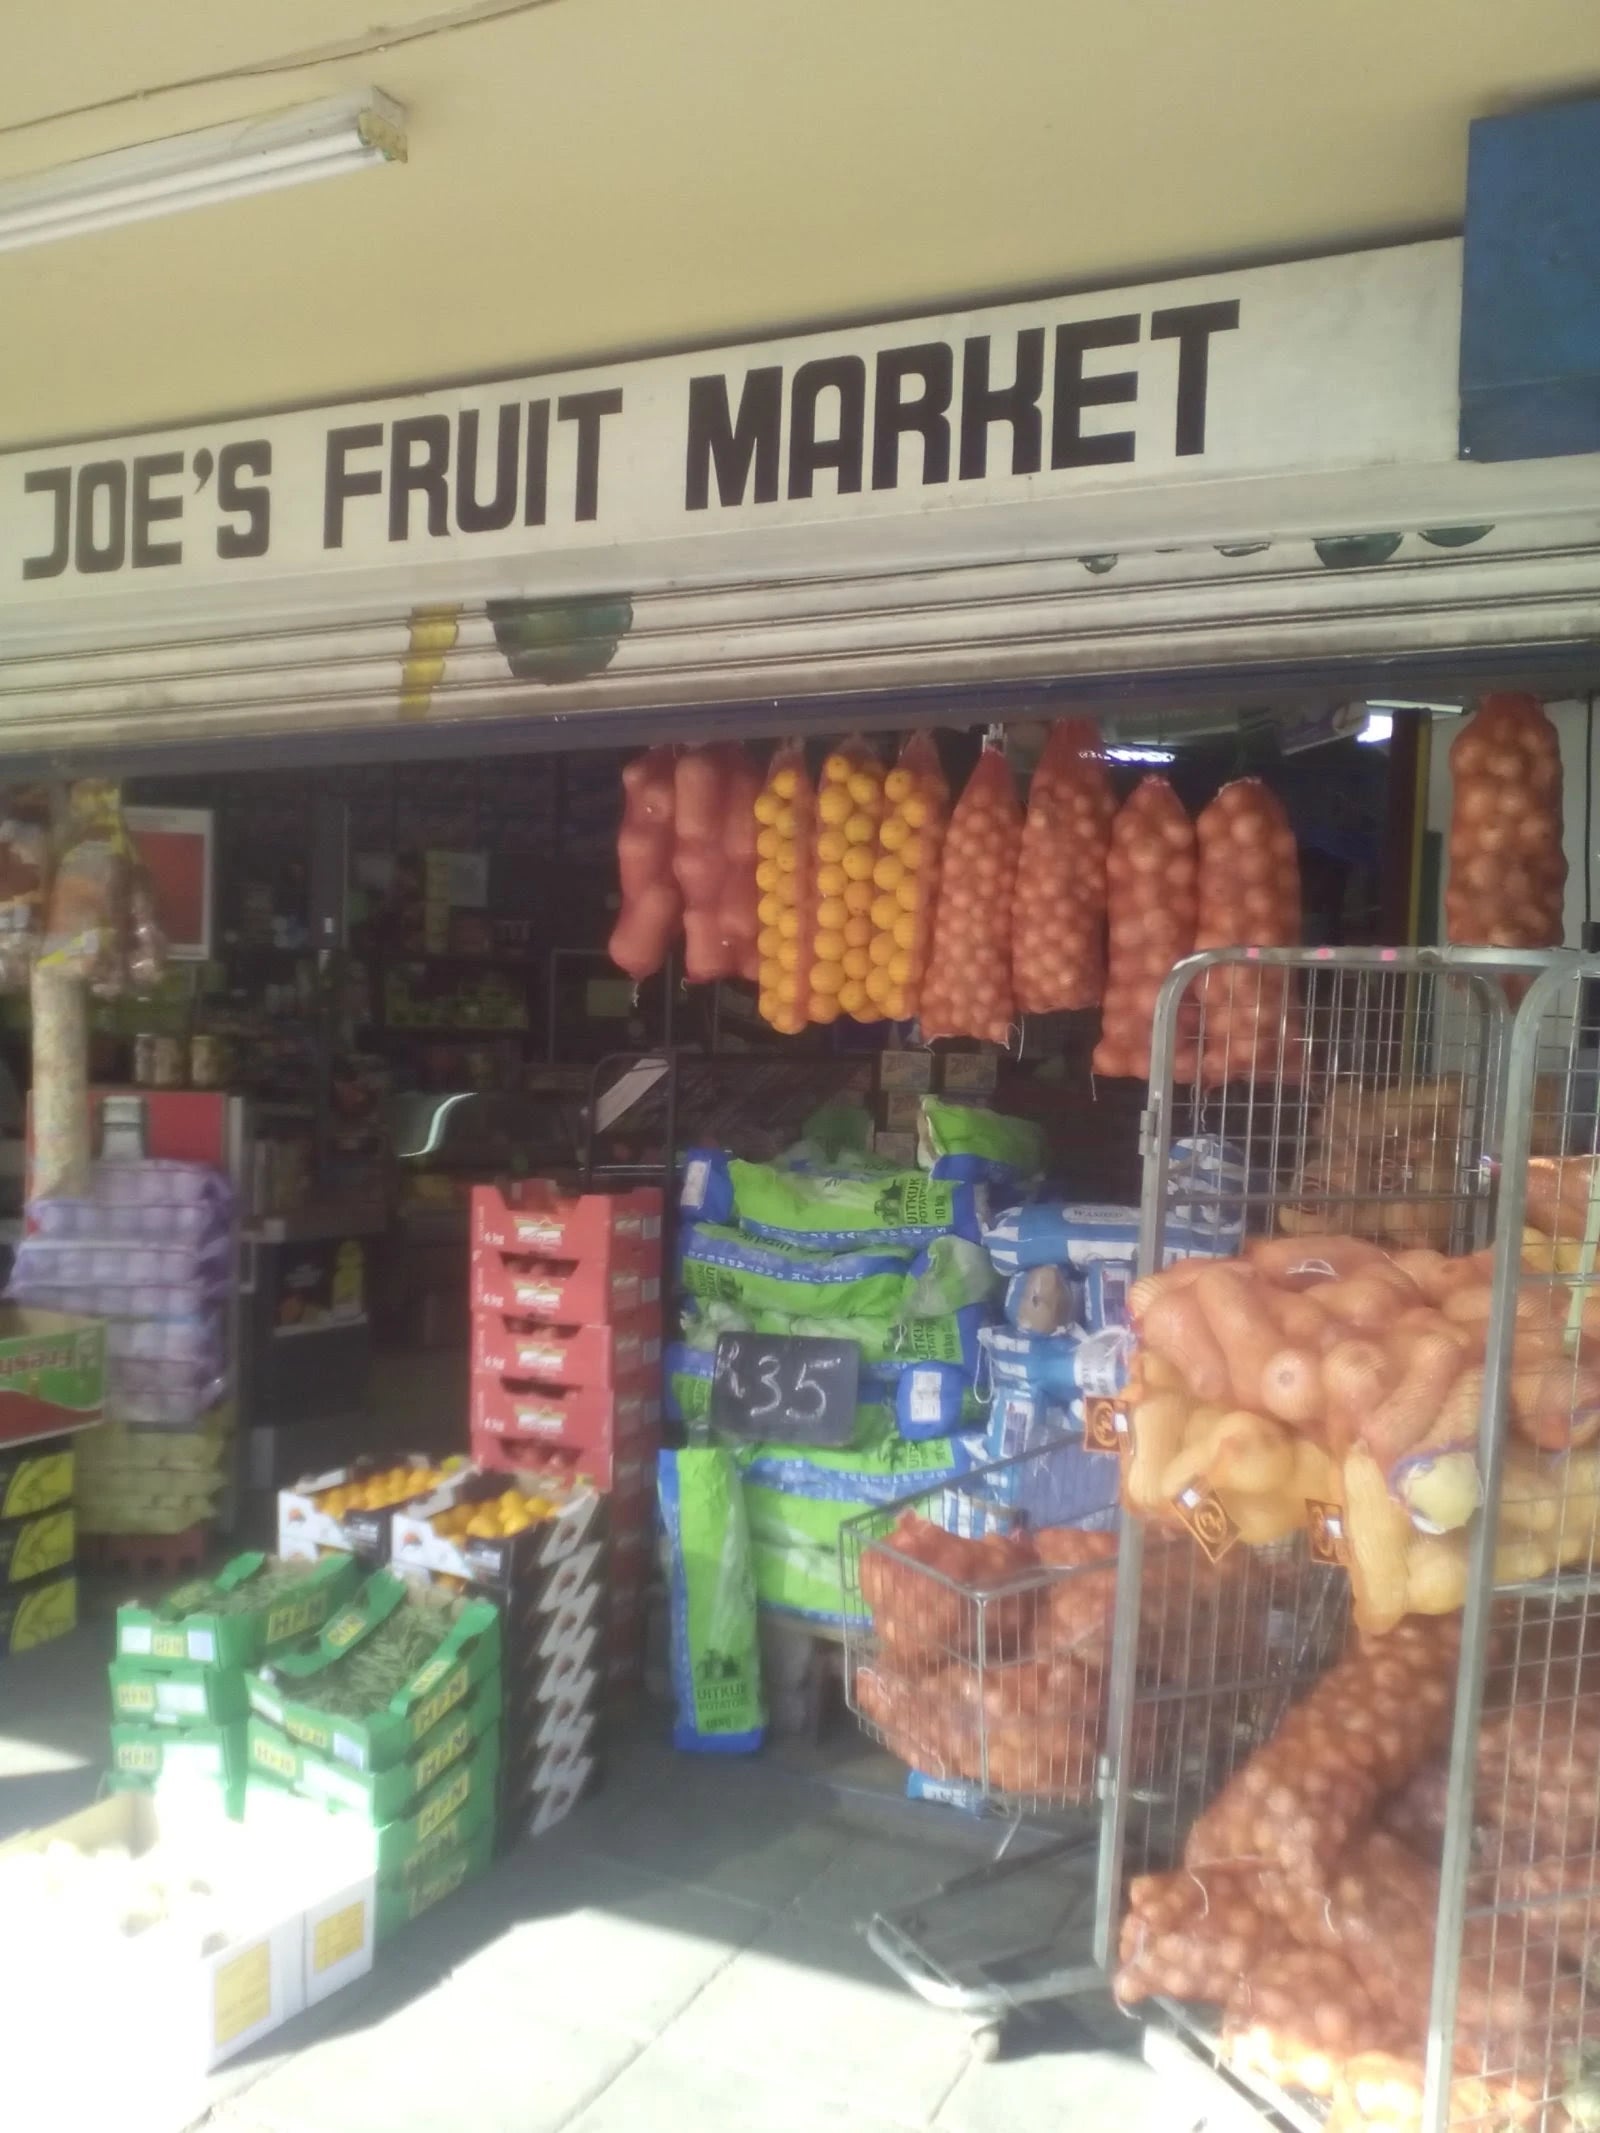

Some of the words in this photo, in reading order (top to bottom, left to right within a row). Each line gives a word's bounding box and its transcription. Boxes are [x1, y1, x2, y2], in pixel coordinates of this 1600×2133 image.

[23, 439, 272, 581] JOE'S
[323, 388, 623, 550] FRUIT
[684, 299, 1240, 511] MARKET
